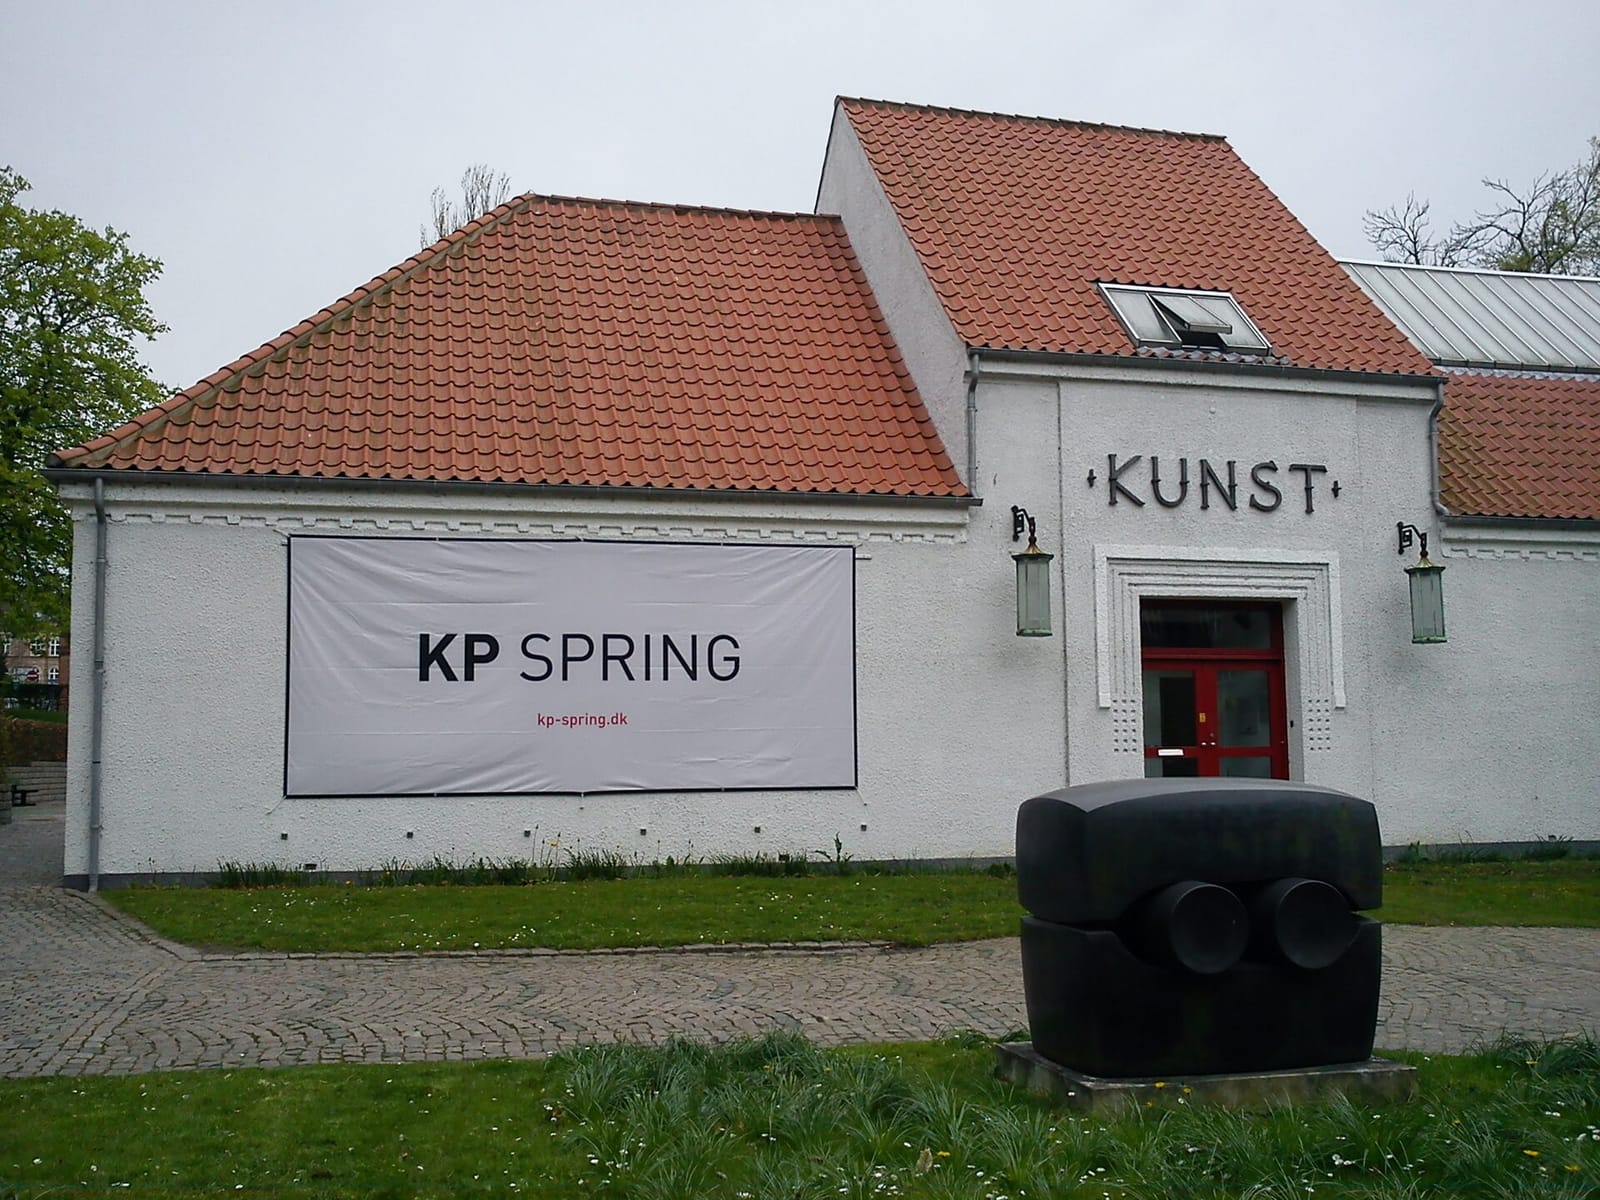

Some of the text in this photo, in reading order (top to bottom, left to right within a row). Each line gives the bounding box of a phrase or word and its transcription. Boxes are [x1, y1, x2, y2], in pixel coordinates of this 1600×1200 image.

[1107, 453, 1329, 515] KUNST
[418, 632, 741, 682] KP SPRING
[537, 712, 628, 729] kp-spring.dk
